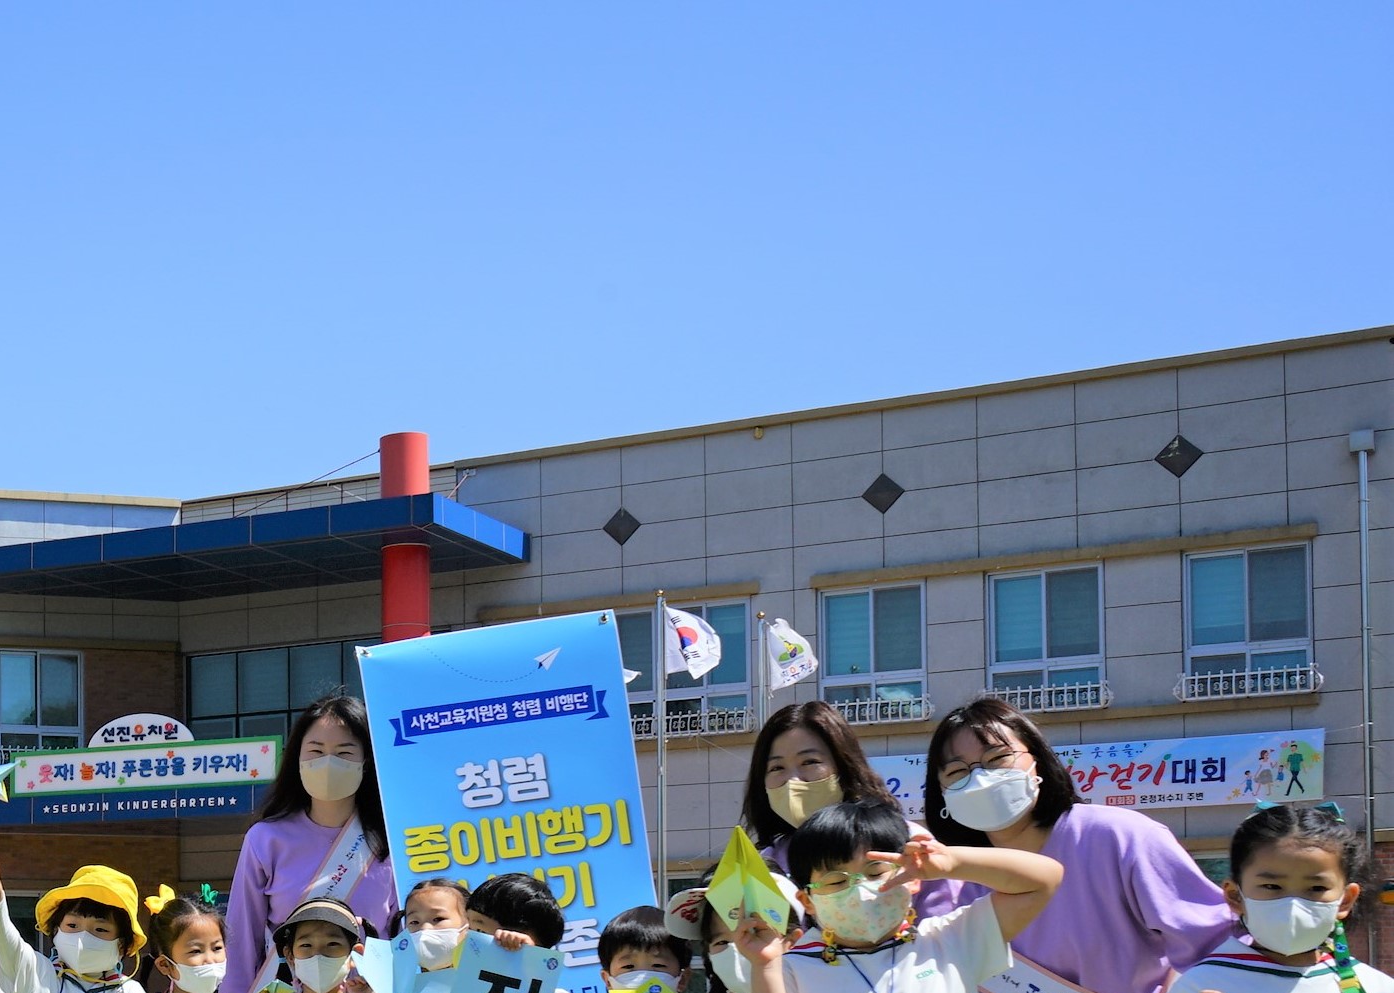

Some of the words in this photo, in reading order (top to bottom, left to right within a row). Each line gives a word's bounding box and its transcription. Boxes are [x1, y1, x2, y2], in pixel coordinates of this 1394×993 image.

[410, 703, 508, 731] 사천교육지원청
[512, 698, 541, 719] 청렴
[546, 692, 589, 713] 비행단
[101, 722, 179, 742] 선진유치원
[38, 762, 75, 783] 웃자!
[79, 760, 116, 781] 놀자!
[121, 755, 186, 777] 푸른꿈을
[192, 753, 248, 774] 키우자!
[456, 752, 551, 808] 청렴
[52, 802, 110, 815] SEONJIN
[117, 796, 226, 811] KINDERGARTEN
[404, 799, 632, 873] 종이비행기
